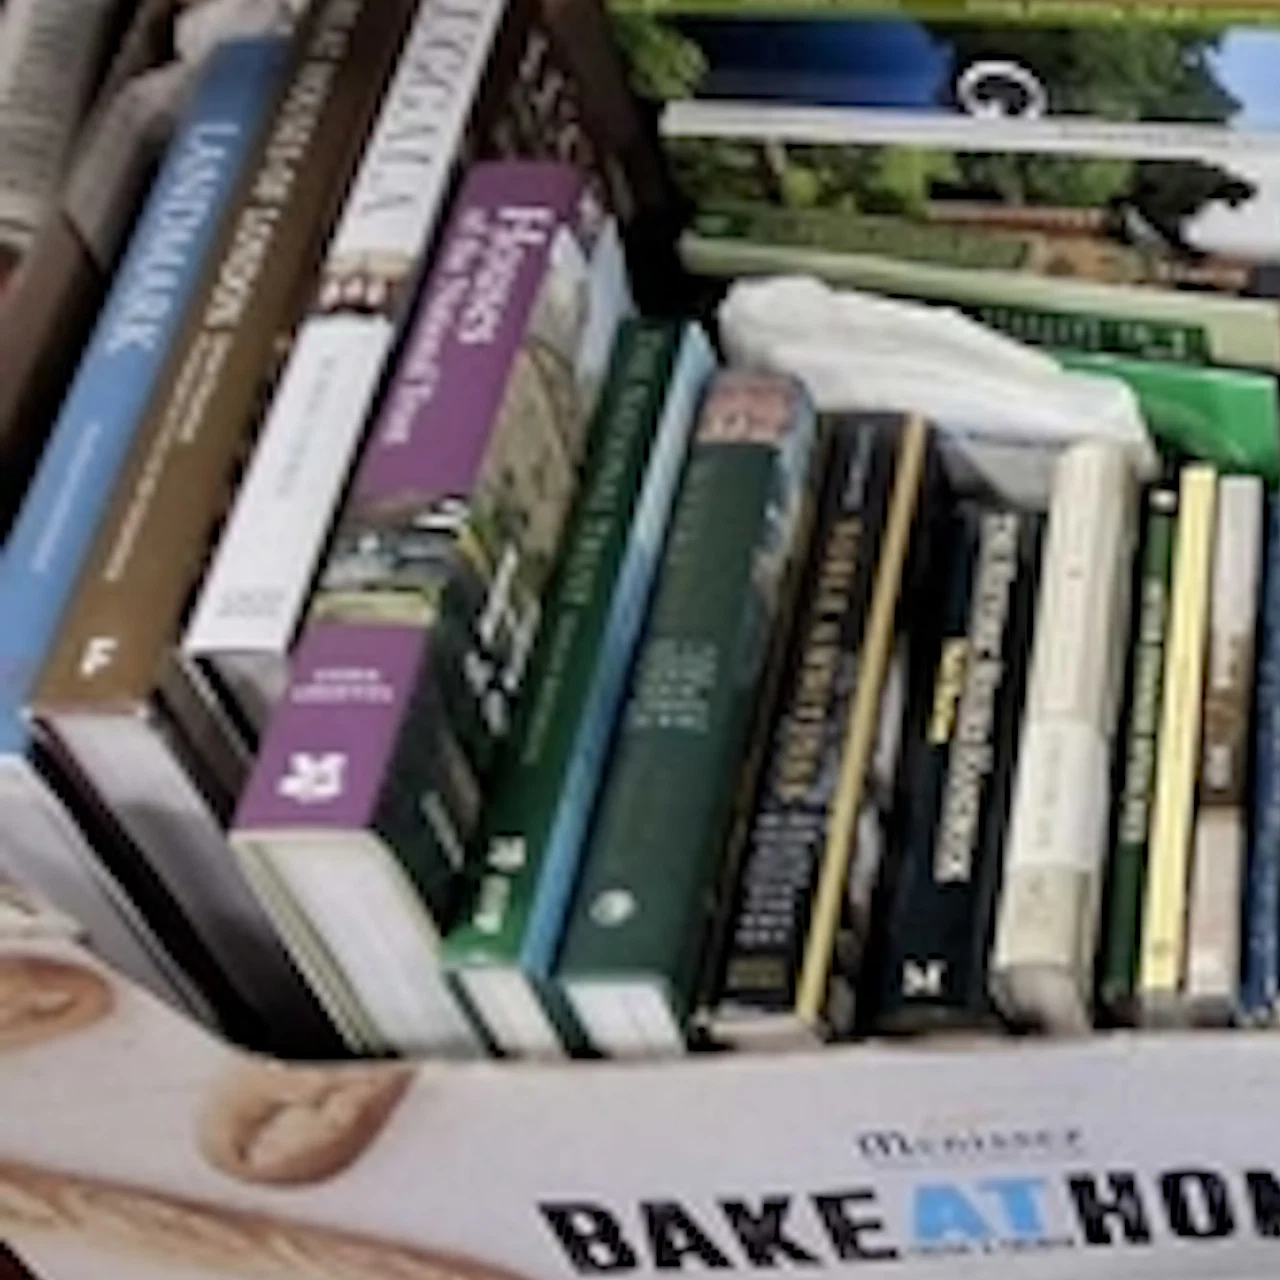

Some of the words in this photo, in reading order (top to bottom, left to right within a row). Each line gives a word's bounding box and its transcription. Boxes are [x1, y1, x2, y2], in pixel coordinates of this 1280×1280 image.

[105, 122, 241, 355] LANDMARK
[538, 1188, 899, 1279] BAKE
[909, 1176, 1060, 1241] AT
